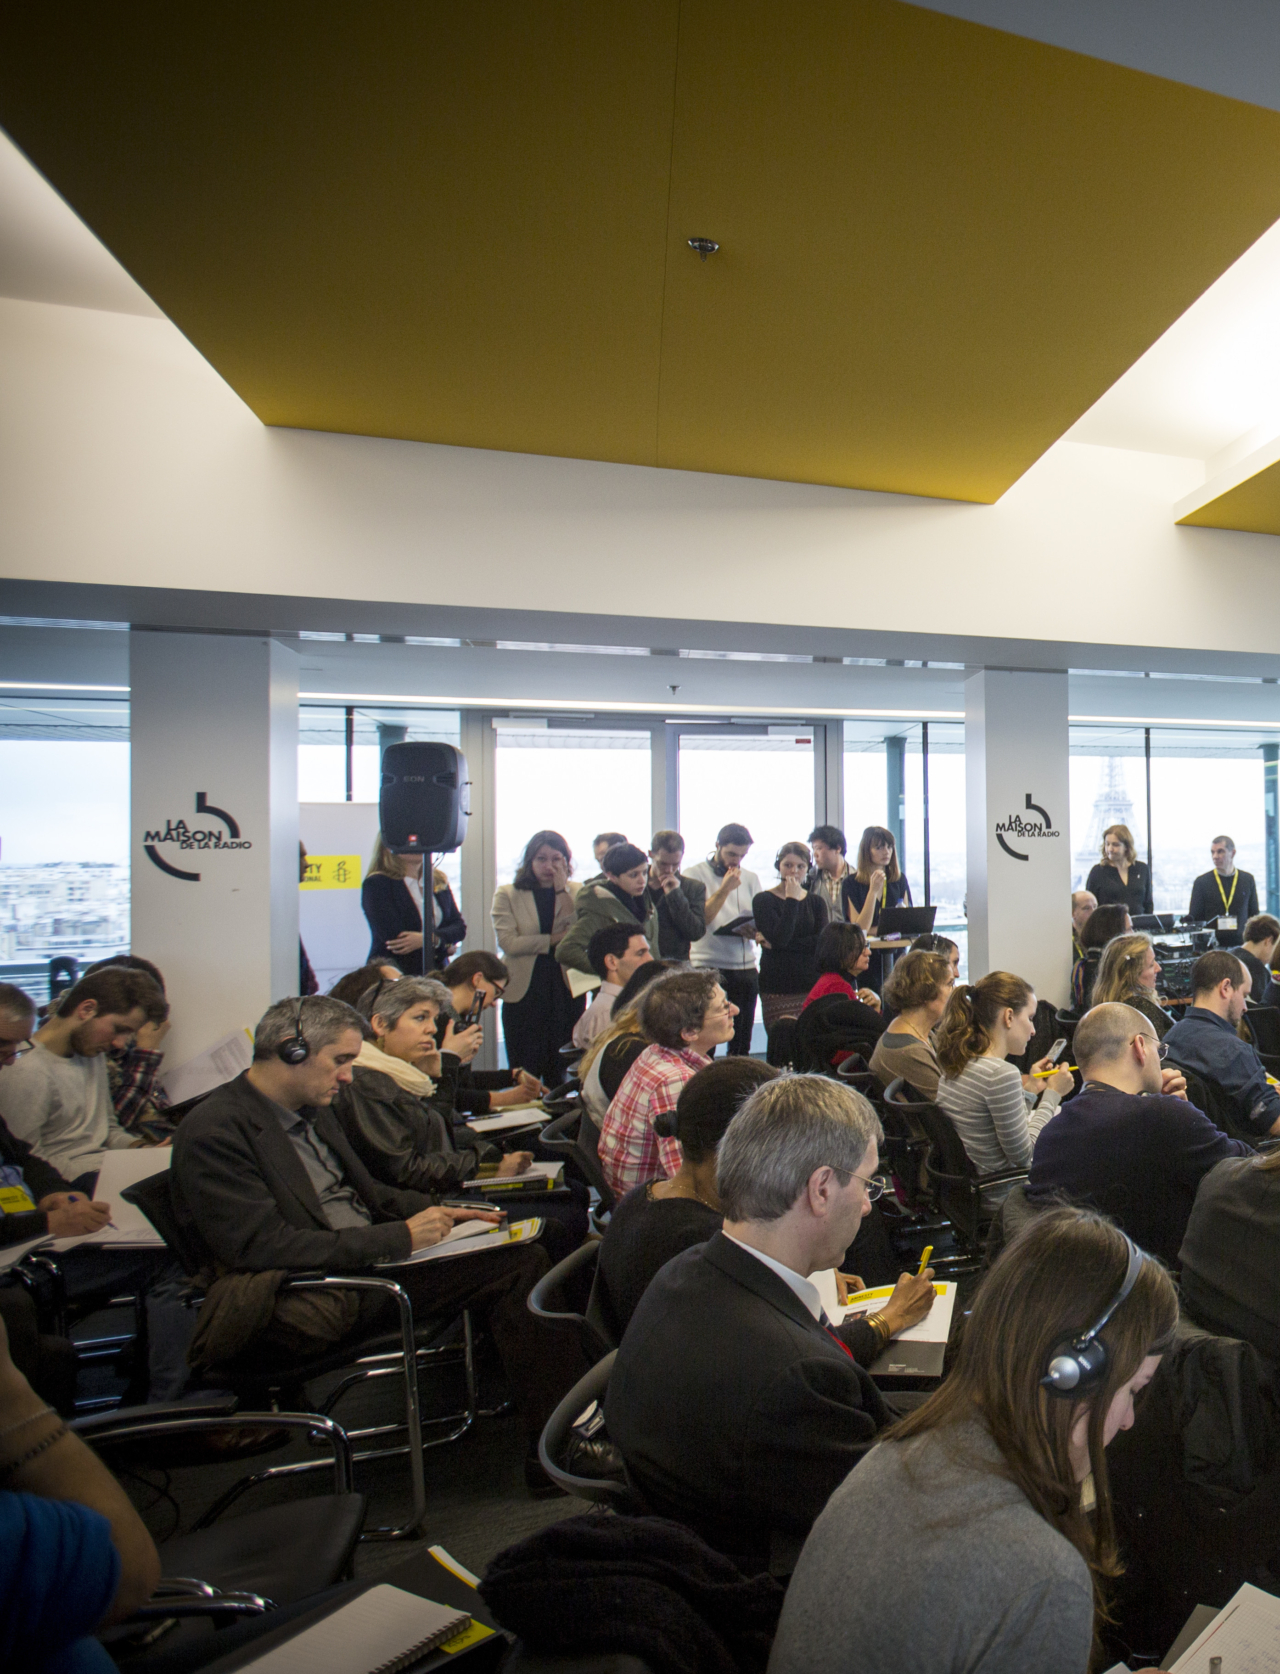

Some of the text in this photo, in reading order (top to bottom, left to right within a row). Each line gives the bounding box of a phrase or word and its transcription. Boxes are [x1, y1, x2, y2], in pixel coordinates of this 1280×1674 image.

[1009, 814, 1022, 824] LA
[167, 819, 188, 831] LA
[996, 823, 1042, 832] MAISON
[143, 831, 222, 842] MAISON
[180, 841, 252, 849] DE LA RADIO
